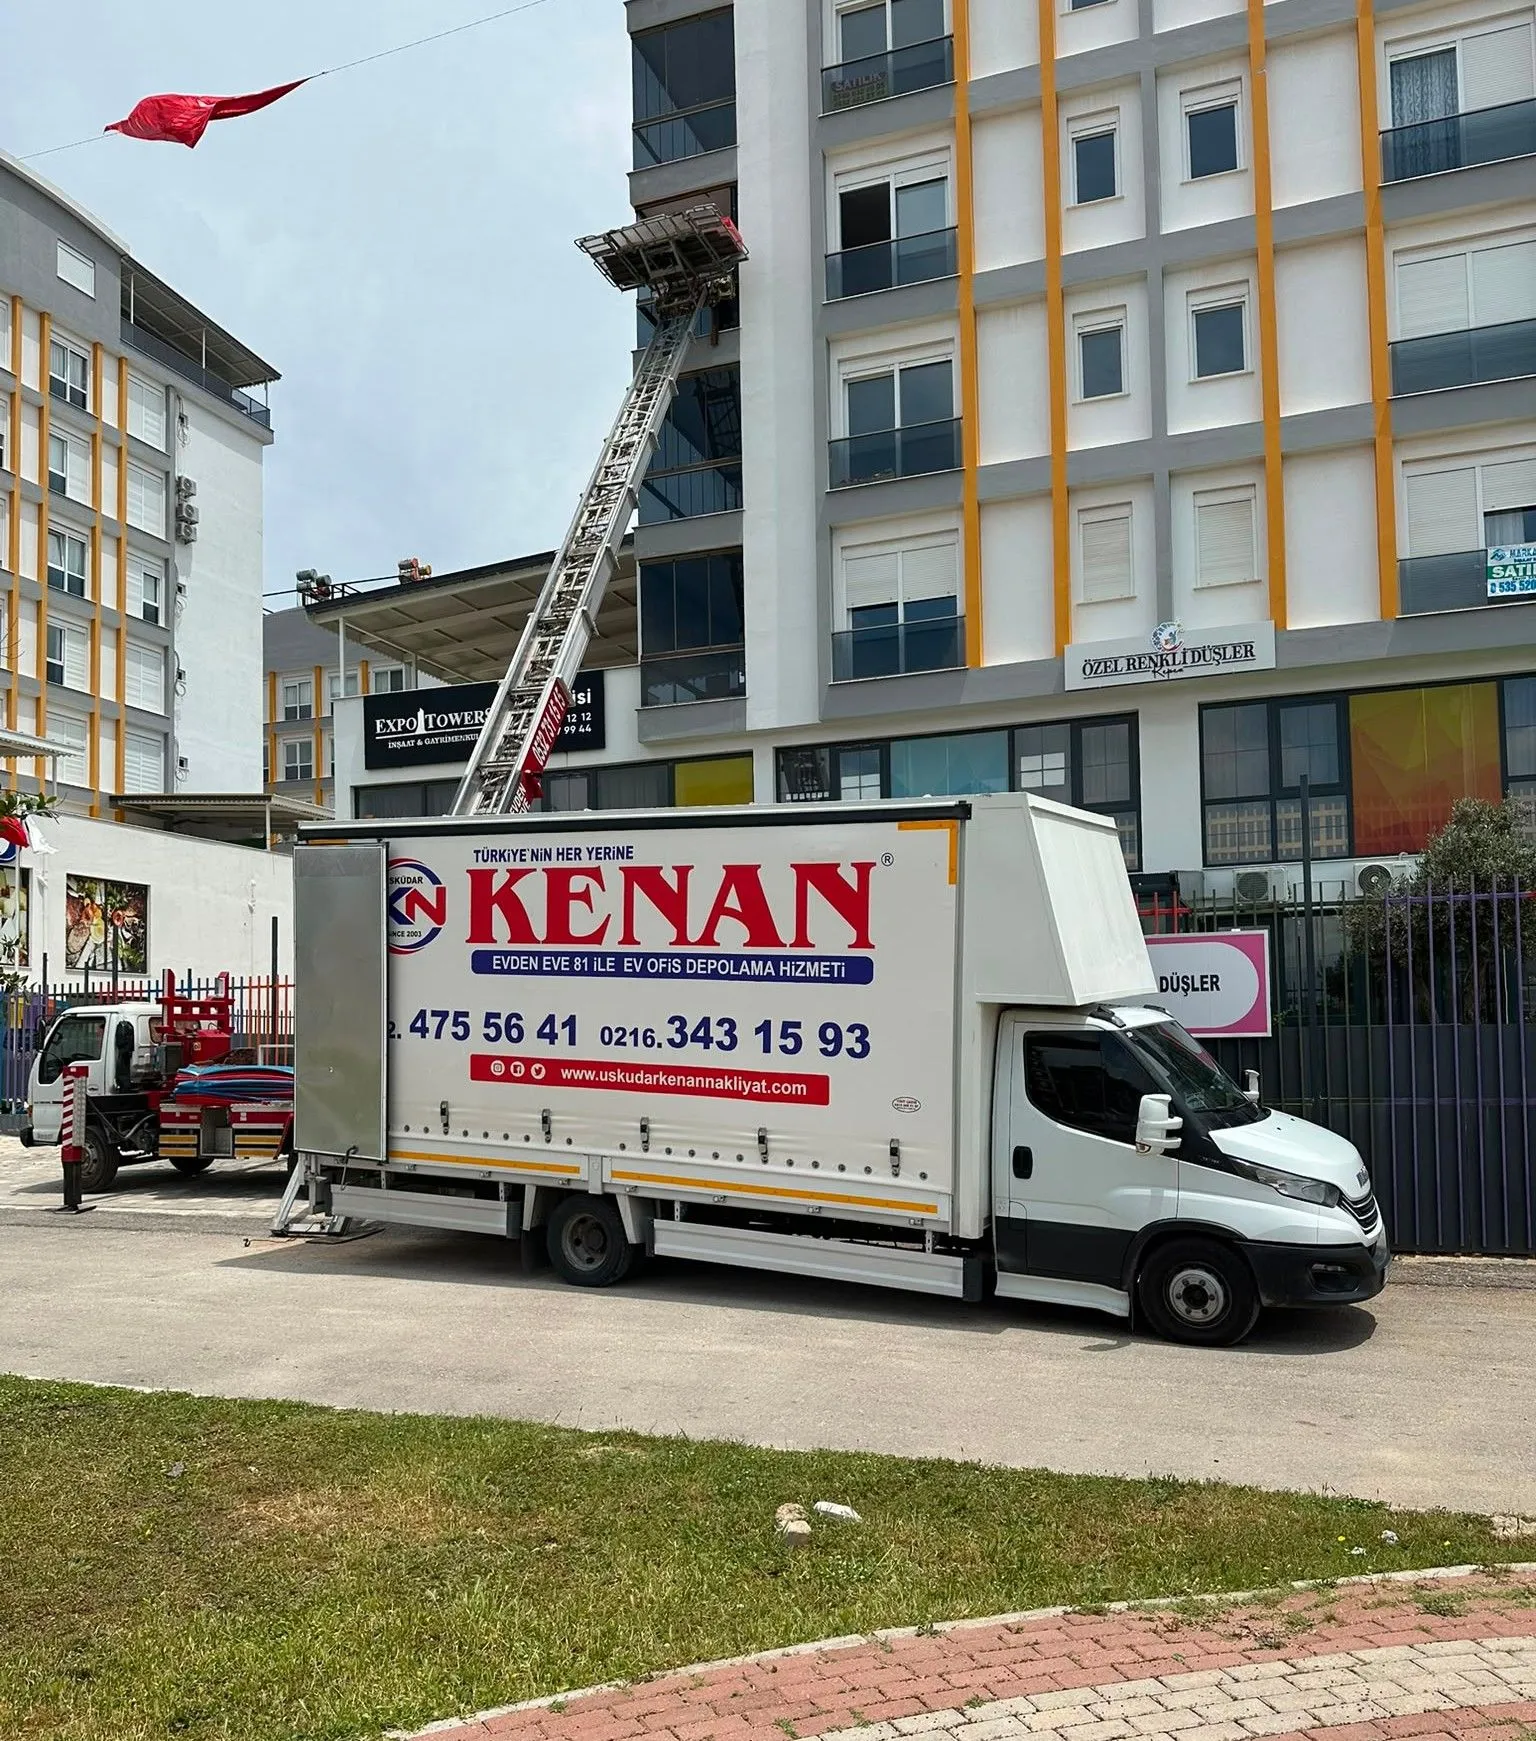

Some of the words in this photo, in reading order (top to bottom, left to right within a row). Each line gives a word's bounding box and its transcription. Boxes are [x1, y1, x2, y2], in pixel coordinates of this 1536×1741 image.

[1499, 581, 1516, 592] 535
[1082, 659, 1123, 677] ÖZEL
[1127, 649, 1188, 671] RENKLİ
[1190, 643, 1256, 667] DÜŞLER
[572, 688, 592, 704] isi
[375, 717, 417, 734] EXPO
[567, 713, 577, 723] 12
[581, 712, 592, 721] 12
[564, 725, 576, 735] 99
[579, 724, 592, 733] 44
[388, 740, 415, 749] İNŞAAT
[556, 847, 582, 862] HER
[389, 875, 423, 885] SKÜDAR
[465, 862, 877, 949] KENAN
[406, 930, 422, 938] 2003
[492, 955, 538, 971] EVDEN
[543, 956, 570, 971] EVE
[574, 957, 588, 971] 81
[623, 958, 643, 973] EV
[686, 958, 776, 976] DEPOLAMA
[1160, 972, 1220, 996] DÜŞLER
[409, 1009, 470, 1041] 475
[482, 1012, 525, 1044] 56
[536, 1014, 577, 1046] 41
[754, 1019, 803, 1055] 15
[818, 1022, 871, 1059] 93
[561, 1067, 807, 1096] www.uskudarkenannakliyat.com
